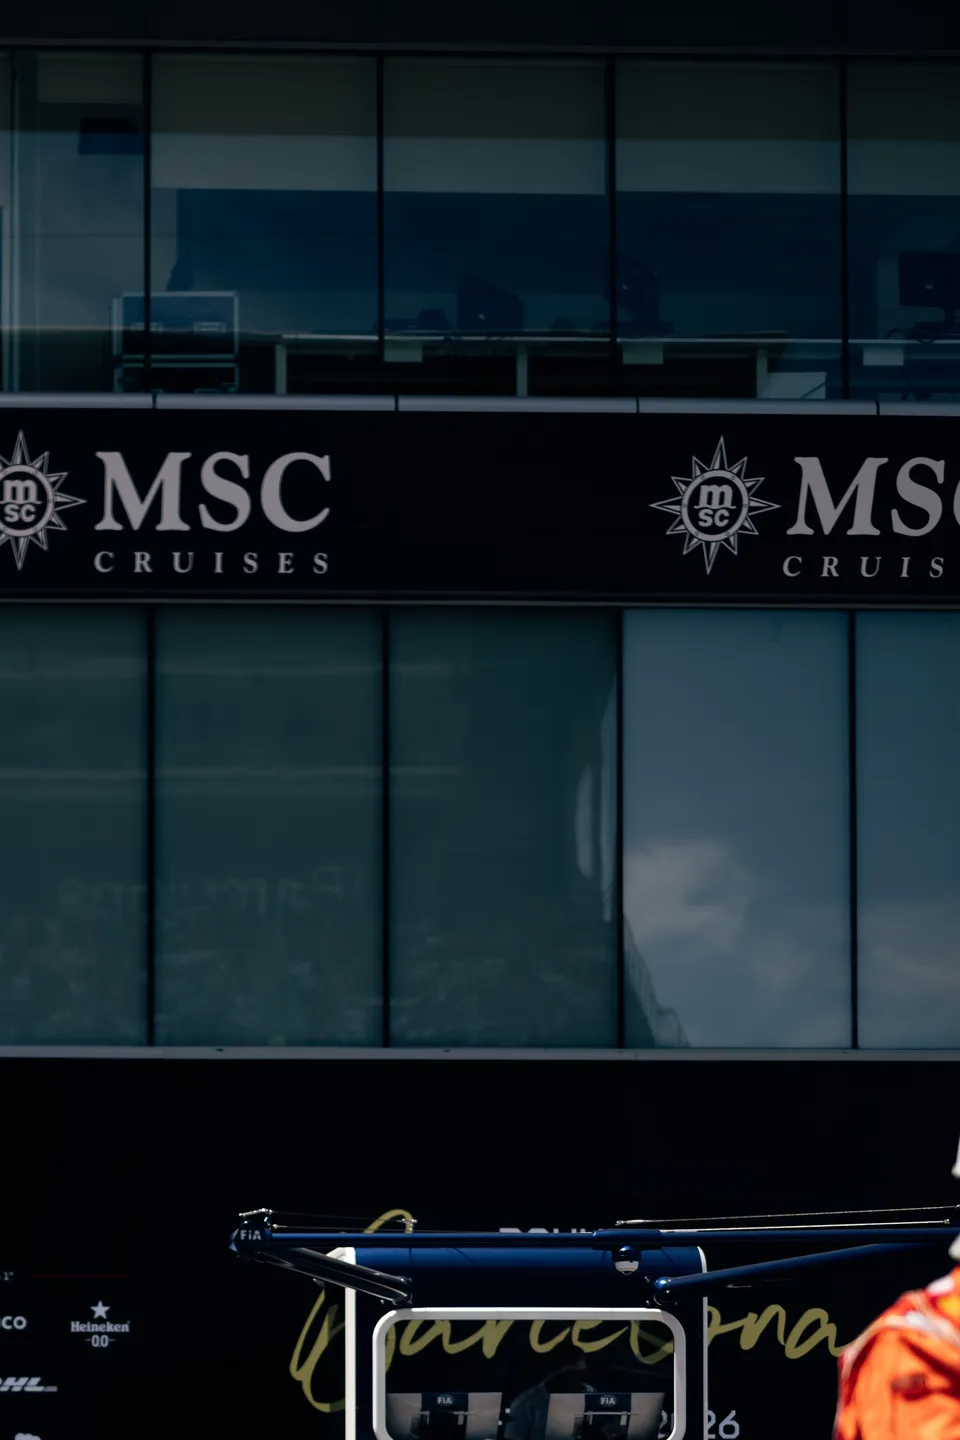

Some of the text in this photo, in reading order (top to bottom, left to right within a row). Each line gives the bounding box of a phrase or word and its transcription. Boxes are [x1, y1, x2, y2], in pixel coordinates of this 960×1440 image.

[94, 451, 332, 533] MSC
[786, 456, 960, 537] MS
[93, 551, 328, 574] CRUISES
[70, 1320, 130, 1333] Heineken
